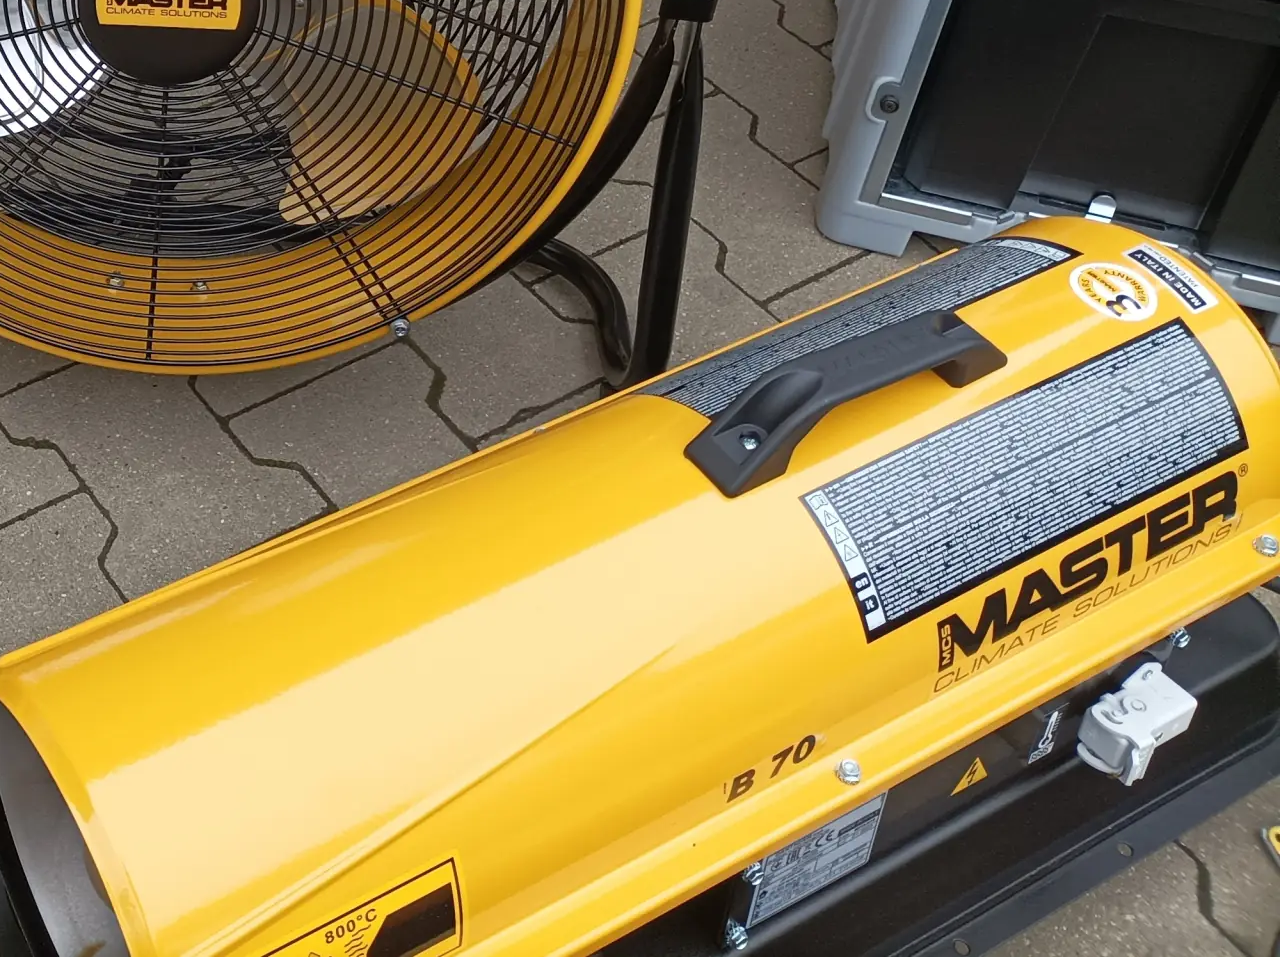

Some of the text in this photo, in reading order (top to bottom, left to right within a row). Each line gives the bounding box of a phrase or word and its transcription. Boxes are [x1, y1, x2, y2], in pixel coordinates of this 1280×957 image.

[106, 7, 227, 19] CLIMATE SOLUTIONS
[1081, 278, 1103, 303] YEARS
[1104, 269, 1147, 302] WARRANTY
[1134, 253, 1202, 307] MADE IN ITALY
[1106, 294, 1142, 317] 3
[949, 470, 1238, 658] MASTER
[855, 576, 869, 588] en
[865, 600, 875, 610] it
[934, 523, 1232, 693] CLIMATE SOLUTIONS
[940, 624, 952, 666] MCS
[726, 734, 816, 803] B 70
[324, 908, 378, 944] 800°C
